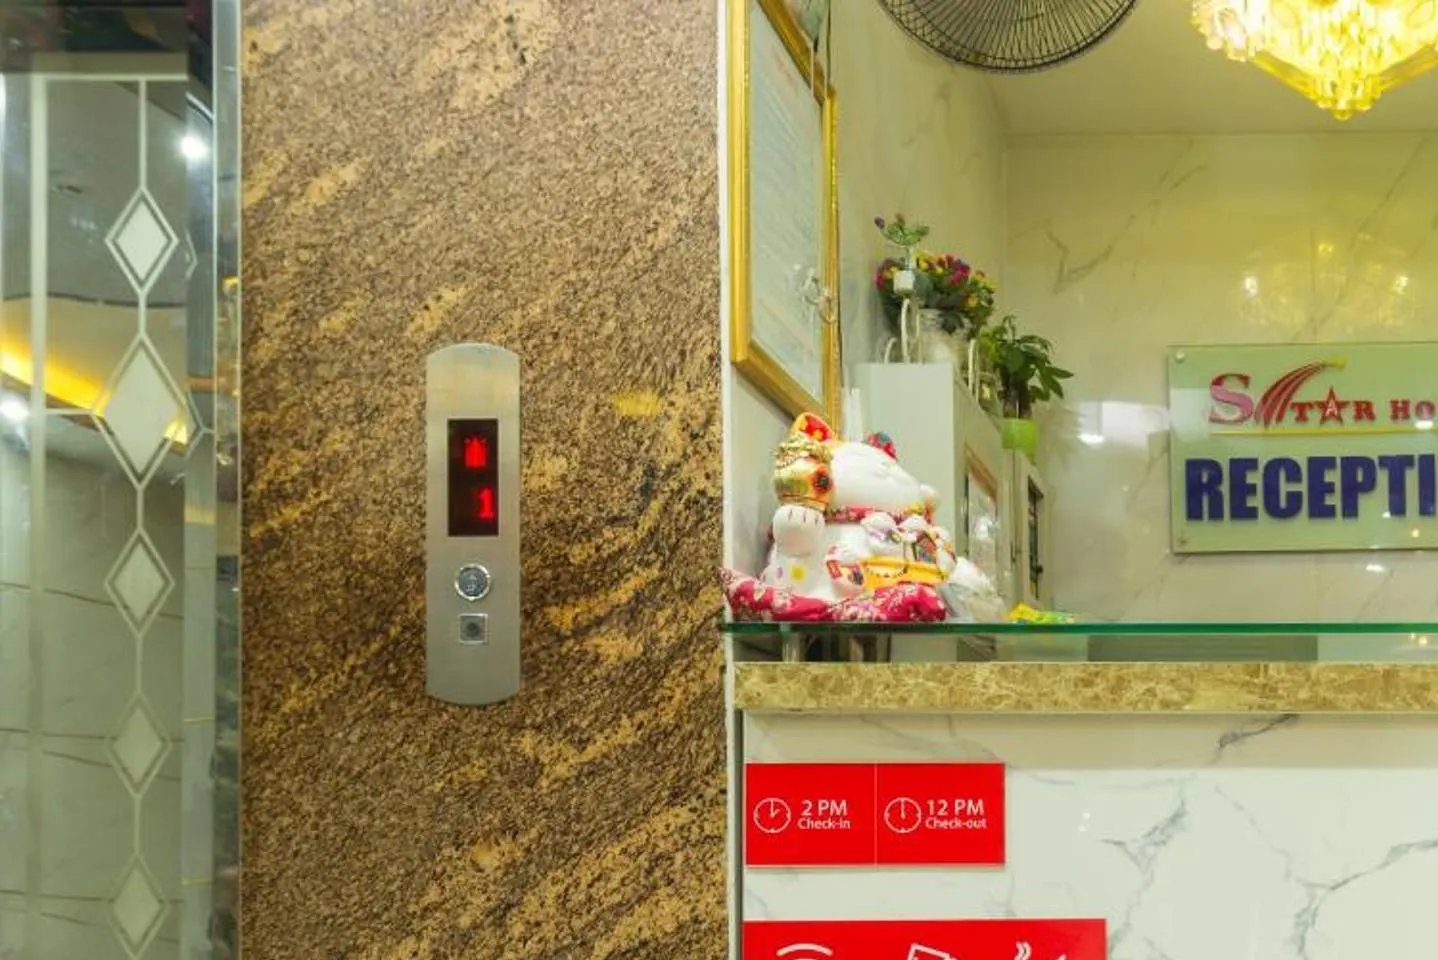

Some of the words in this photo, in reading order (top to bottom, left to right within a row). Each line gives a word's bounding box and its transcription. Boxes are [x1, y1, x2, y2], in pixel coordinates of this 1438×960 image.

[478, 487, 494, 519] 1
[801, 800, 812, 816] 2
[818, 800, 848, 816] PM
[927, 800, 948, 816] 12
[954, 800, 984, 816] PM
[798, 817, 851, 830] Check-in
[925, 817, 987, 830] Check-out
